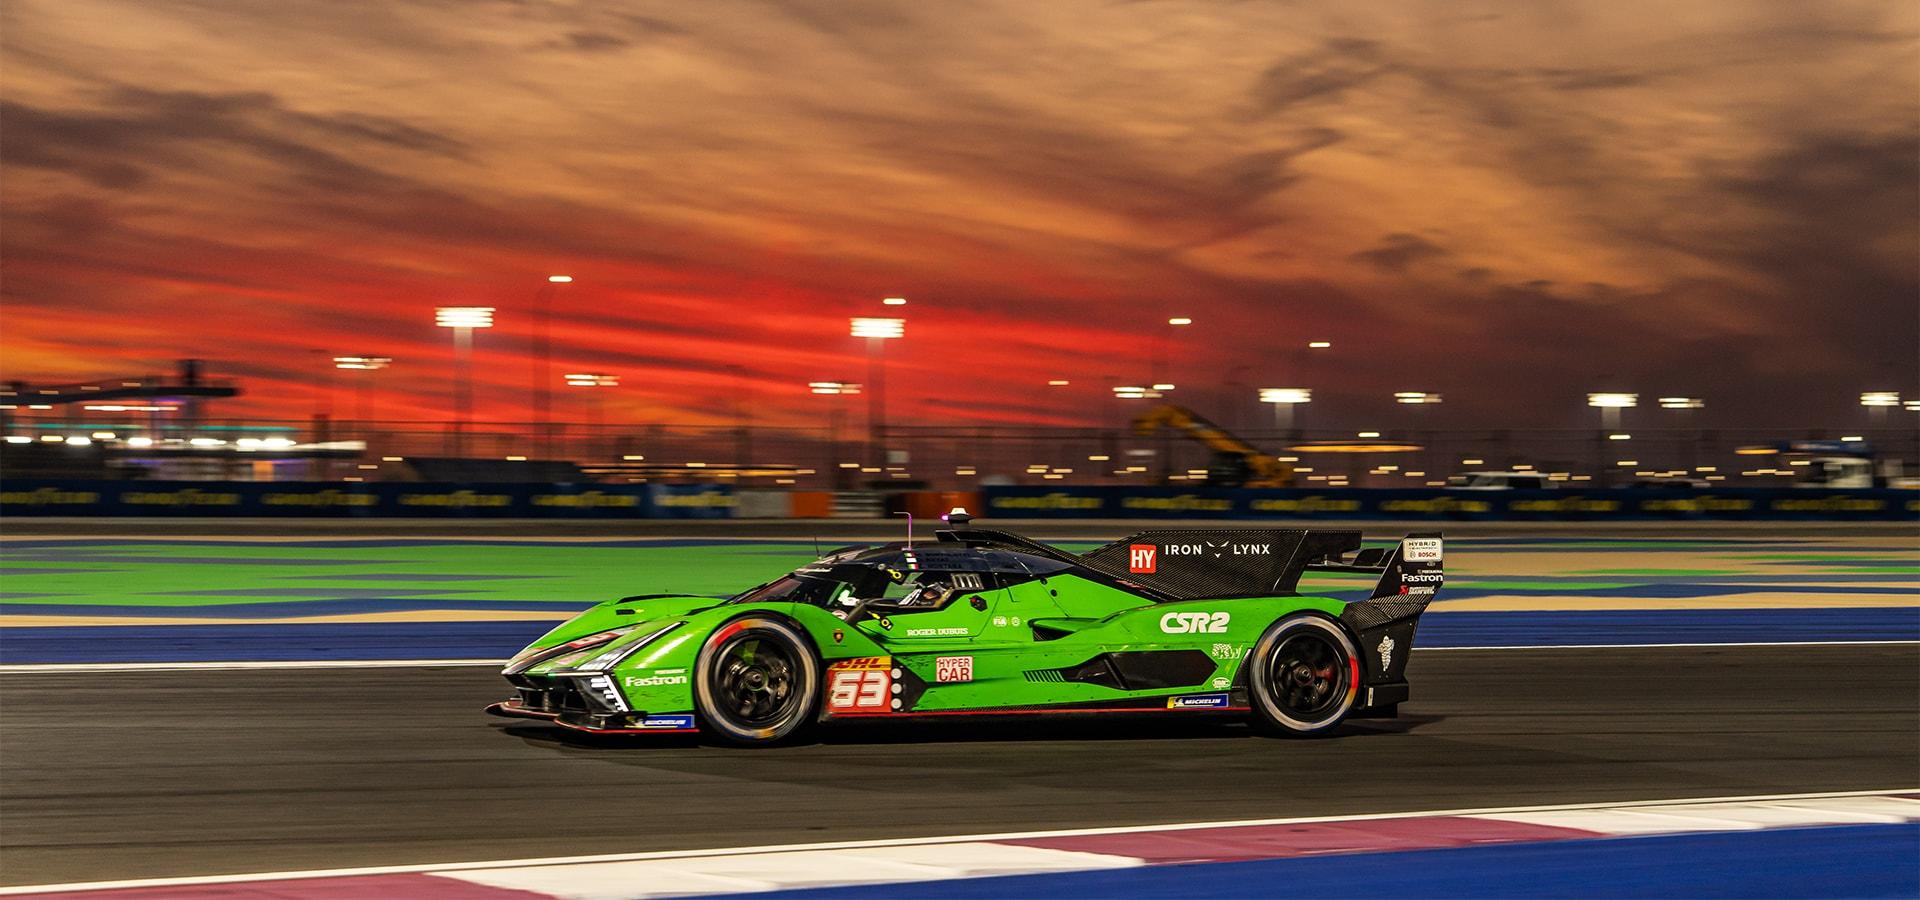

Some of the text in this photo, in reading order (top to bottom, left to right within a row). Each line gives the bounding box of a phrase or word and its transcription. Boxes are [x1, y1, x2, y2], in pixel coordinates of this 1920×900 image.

[1164, 544, 1270, 555] IRON LYNX
[1130, 549, 1155, 569] HY
[1401, 573, 1443, 582] Fastron
[1160, 612, 1231, 634] CSR2
[835, 657, 882, 669] DHL
[938, 658, 970, 668] HYPER
[939, 668, 970, 681] CAR
[625, 676, 687, 687] Fastron
[829, 671, 889, 707] 63
